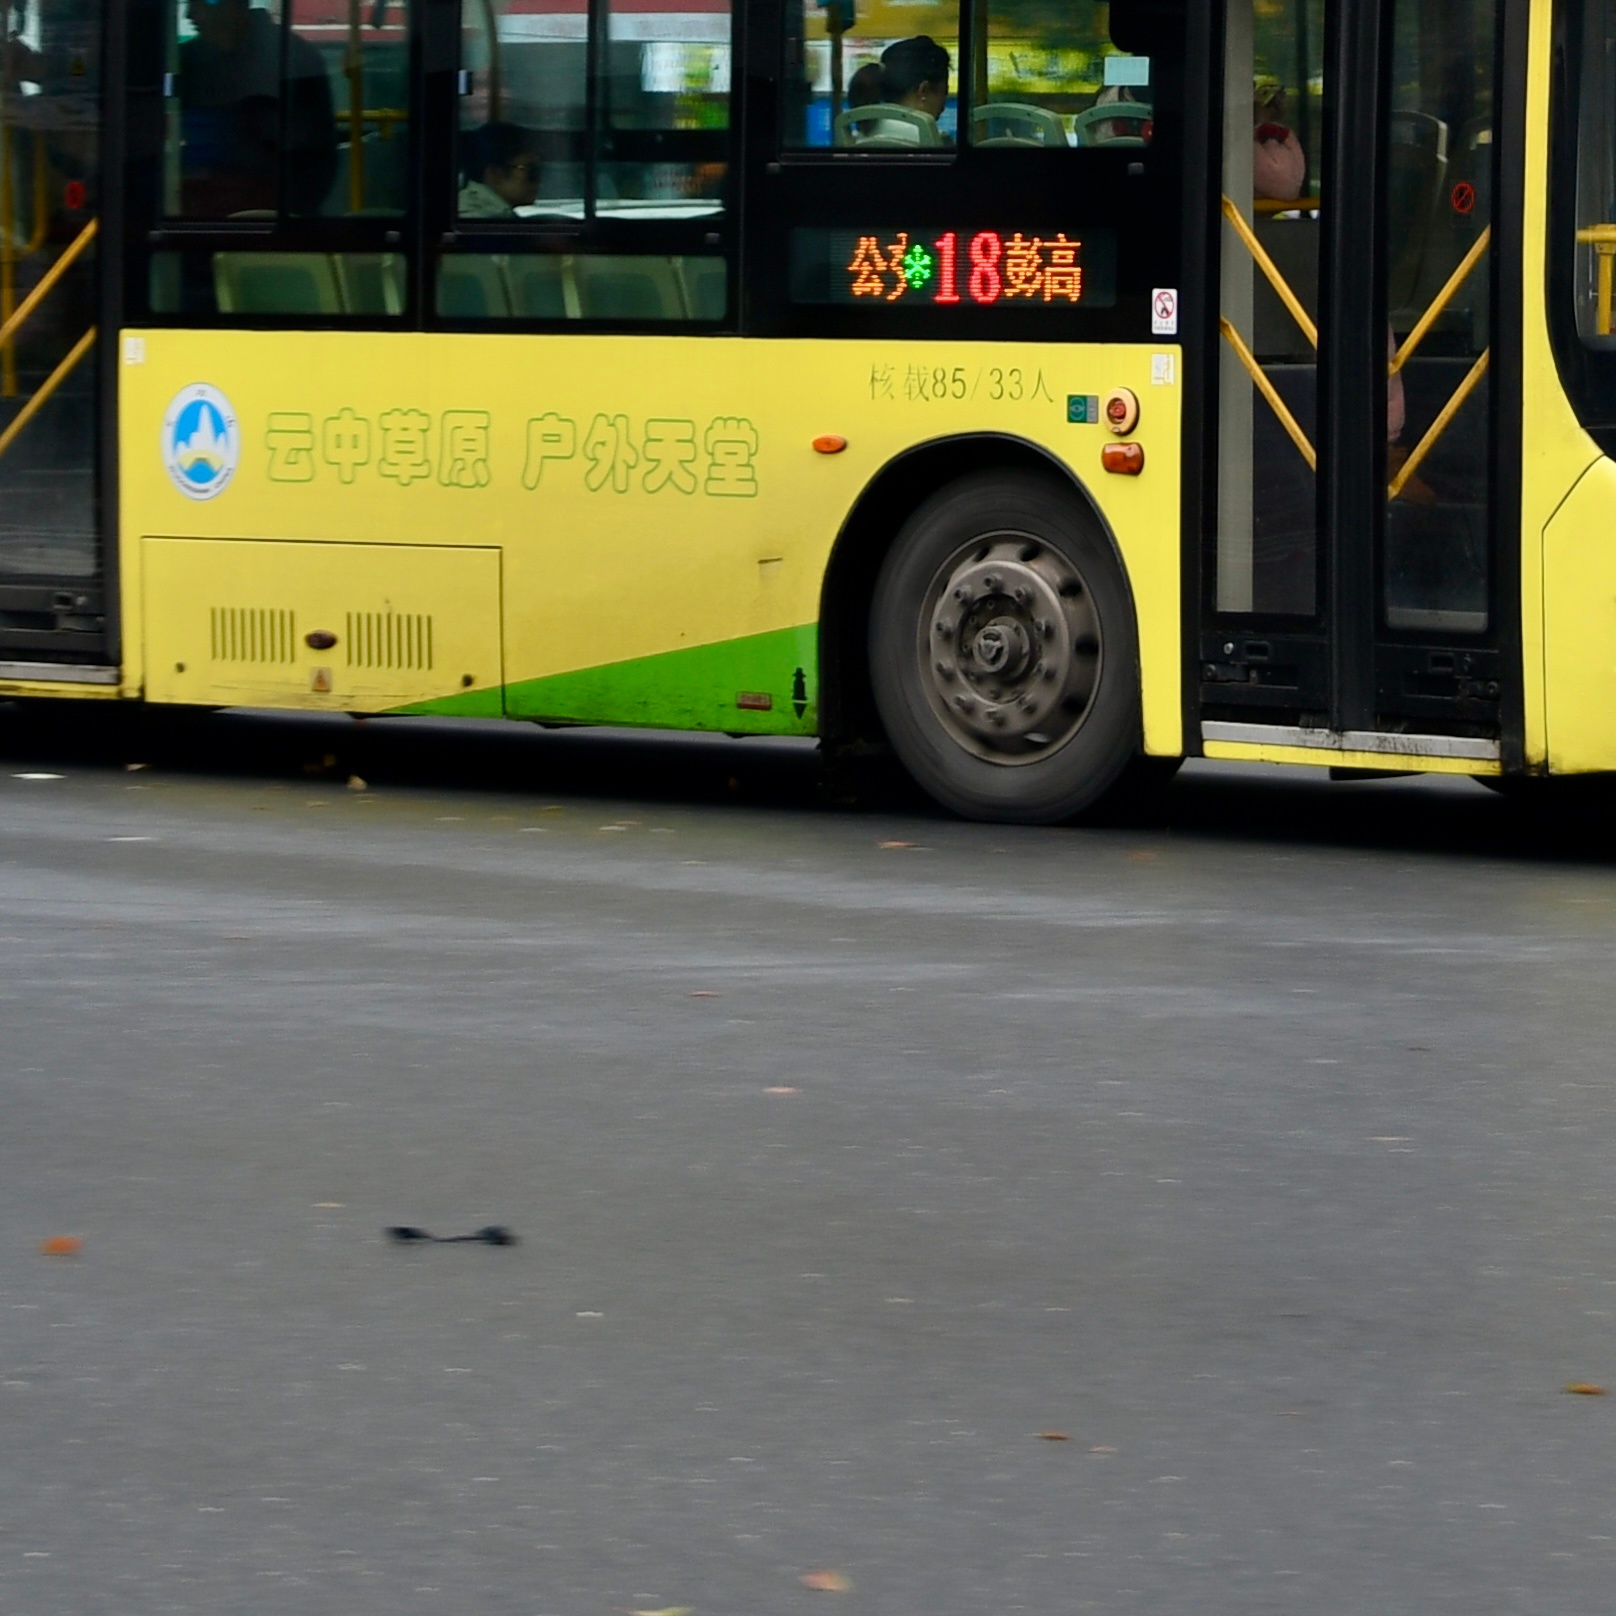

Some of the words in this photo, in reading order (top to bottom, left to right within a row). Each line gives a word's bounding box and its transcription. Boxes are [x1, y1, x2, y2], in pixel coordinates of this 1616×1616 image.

[934, 232, 1003, 303] 18
[1004, 233, 1082, 302] 彭高
[266, 407, 489, 487] 云中草原
[522, 411, 758, 497] 户外天堂
